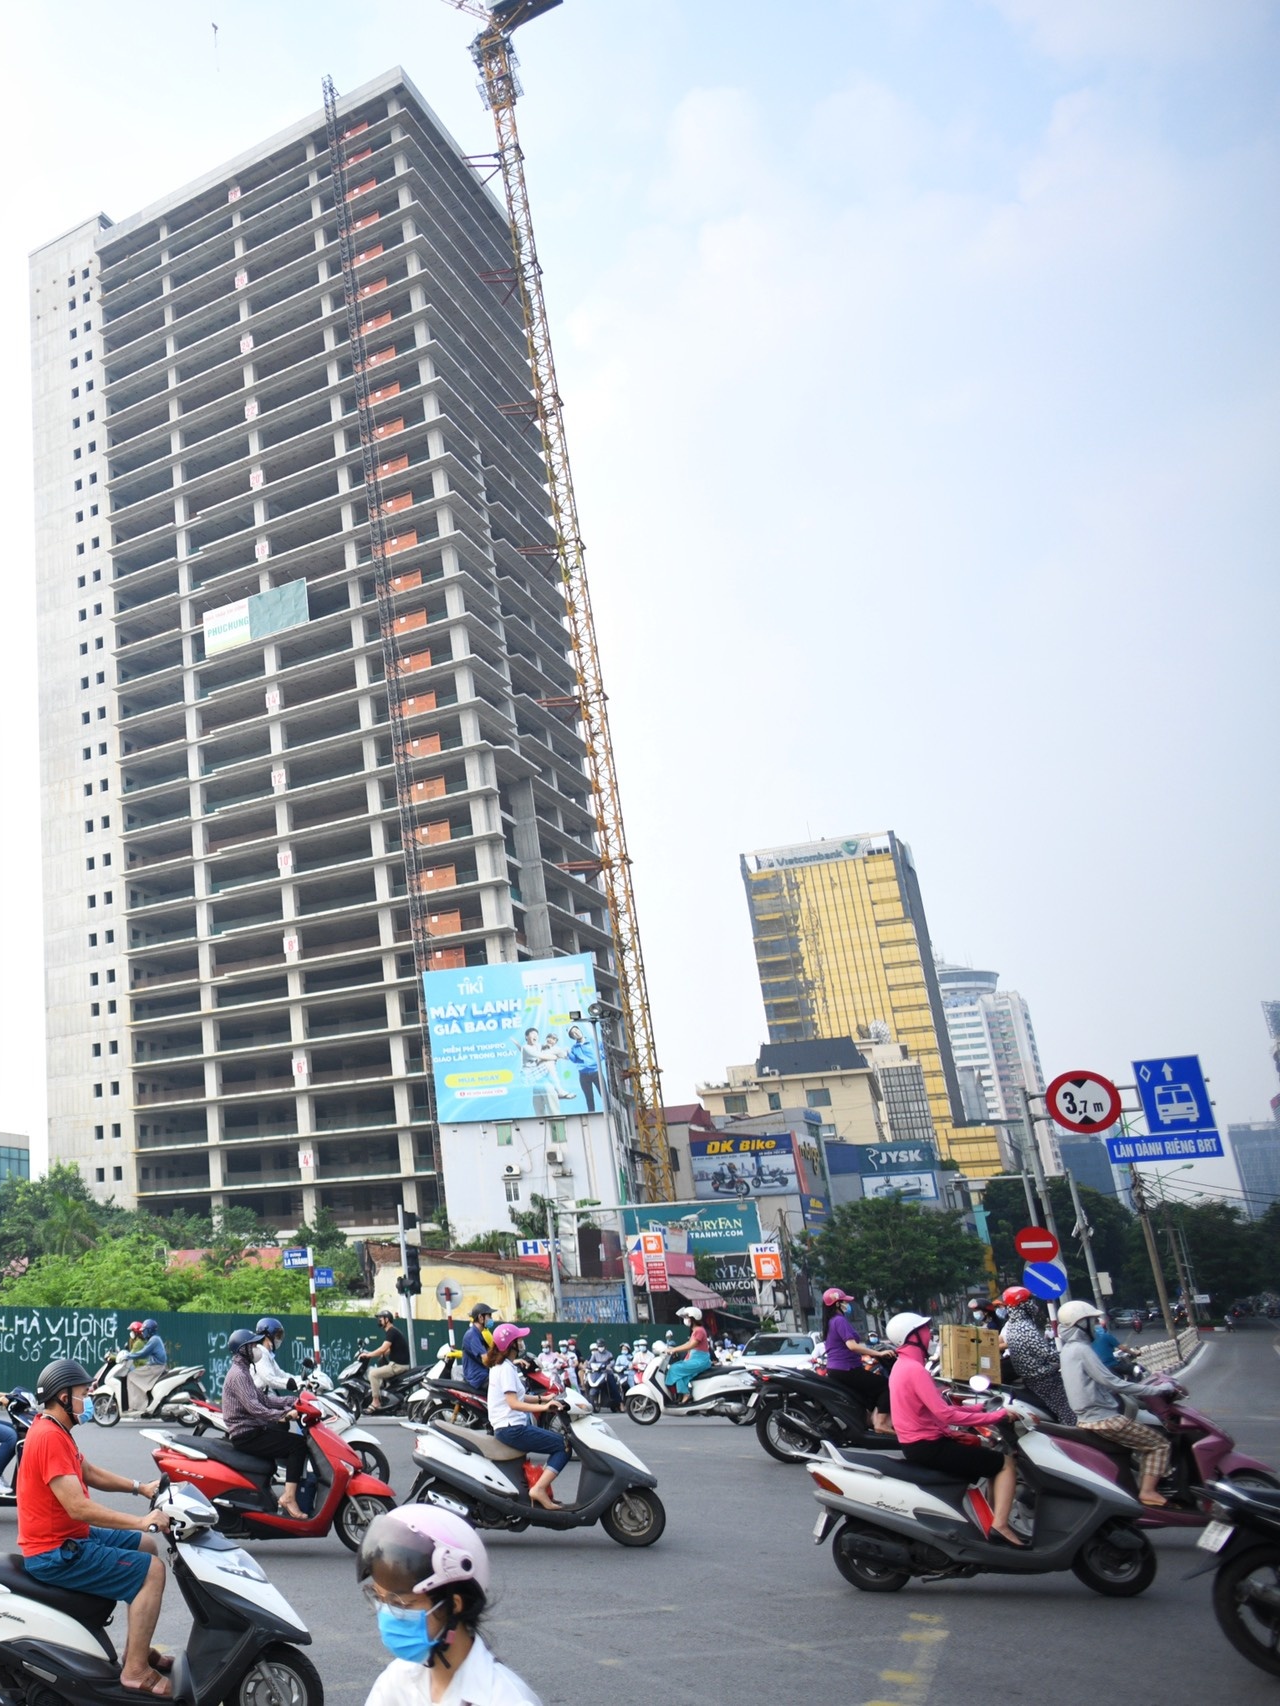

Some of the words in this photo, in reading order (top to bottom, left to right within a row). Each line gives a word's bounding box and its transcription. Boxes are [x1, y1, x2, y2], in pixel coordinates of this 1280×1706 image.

[776, 849, 844, 868] Vietcombank
[429, 1001, 467, 1019] MÁY
[471, 998, 522, 1018] LẠNH
[433, 1020, 462, 1036] GIÁ
[501, 1013, 522, 1029] RẺ
[443, 1044, 461, 1054] MIỄN
[463, 1043, 475, 1052] PHÍ
[477, 1042, 506, 1052] TIKIPRO
[469, 1052, 496, 1061] TRONG
[497, 1049, 517, 1057] NGÀY
[1062, 1091, 1088, 1116] 3,7
[1093, 1101, 1104, 1113] m
[706, 1140, 734, 1154] DK
[739, 1139, 777, 1152] Bike
[1113, 1141, 1134, 1159] LÀN
[1135, 1139, 1164, 1156] DÀNH
[1165, 1137, 1196, 1155] RIÊNG
[1198, 1138, 1218, 1153] BRT
[879, 1150, 922, 1165] JYSK
[284, 1258, 291, 1266] LA
[14, 1310, 40, 1335] HÀ
